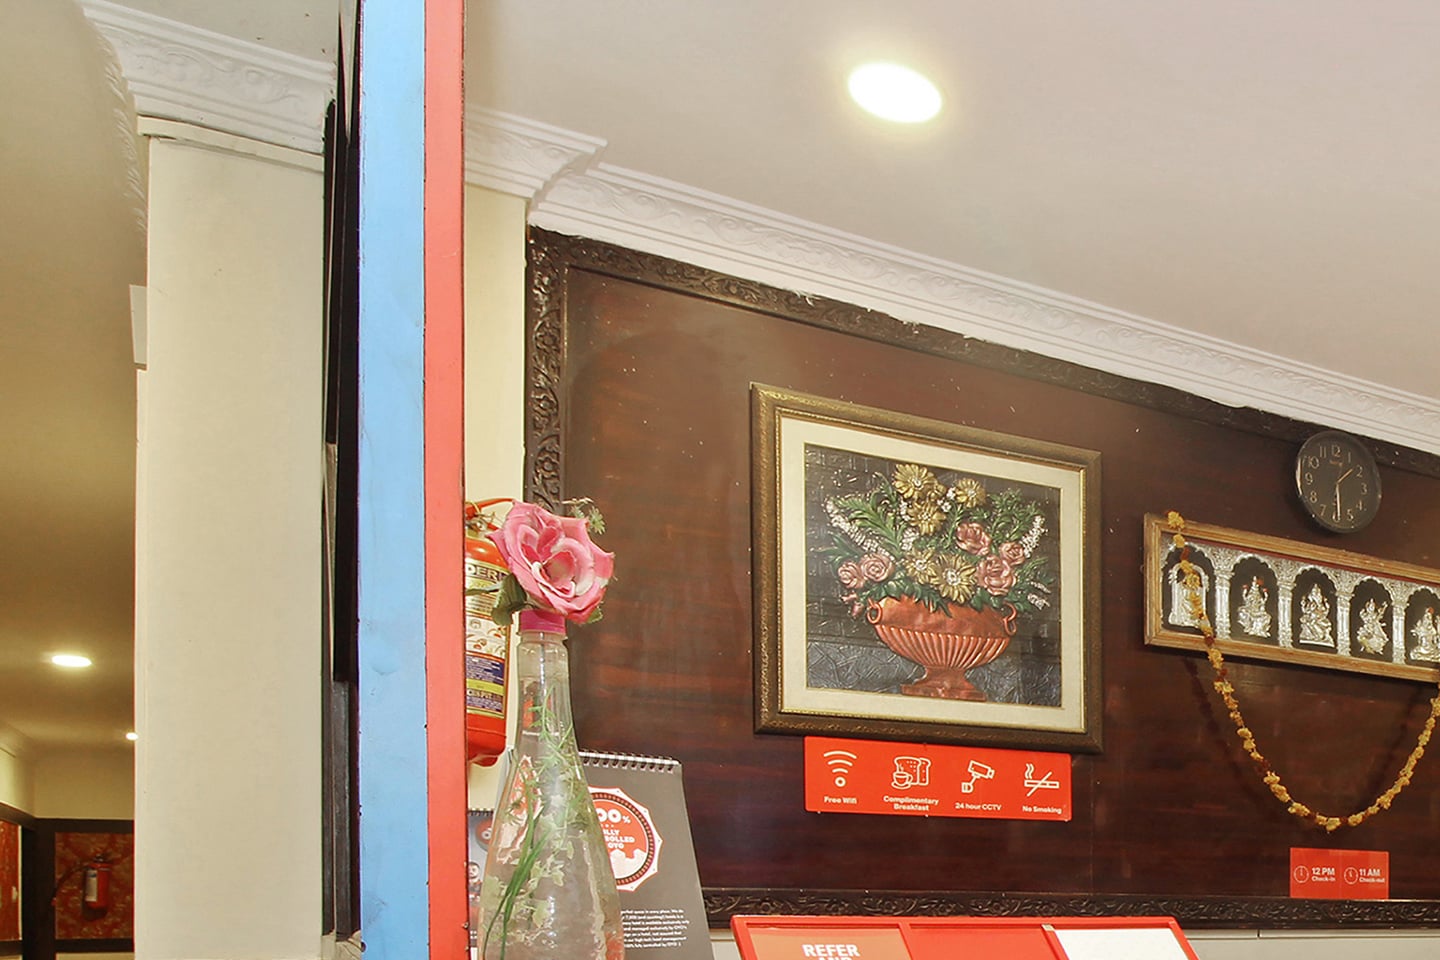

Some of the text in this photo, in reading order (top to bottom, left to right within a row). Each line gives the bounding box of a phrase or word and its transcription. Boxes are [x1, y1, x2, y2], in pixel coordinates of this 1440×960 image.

[1356, 464, 1363, 477] 2
[1305, 472, 1313, 485] 9
[1361, 483, 1368, 495] 3
[1310, 490, 1317, 503] 8
[1320, 504, 1327, 516] 7
[1347, 509, 1354, 521] 5
[883, 795, 939, 806] Complimentary
[596, 808, 631, 824] 00%
[1033, 806, 1062, 814] Smoking
[1312, 868, 1335, 876] 12 PM
[802, 944, 861, 957] REFER
